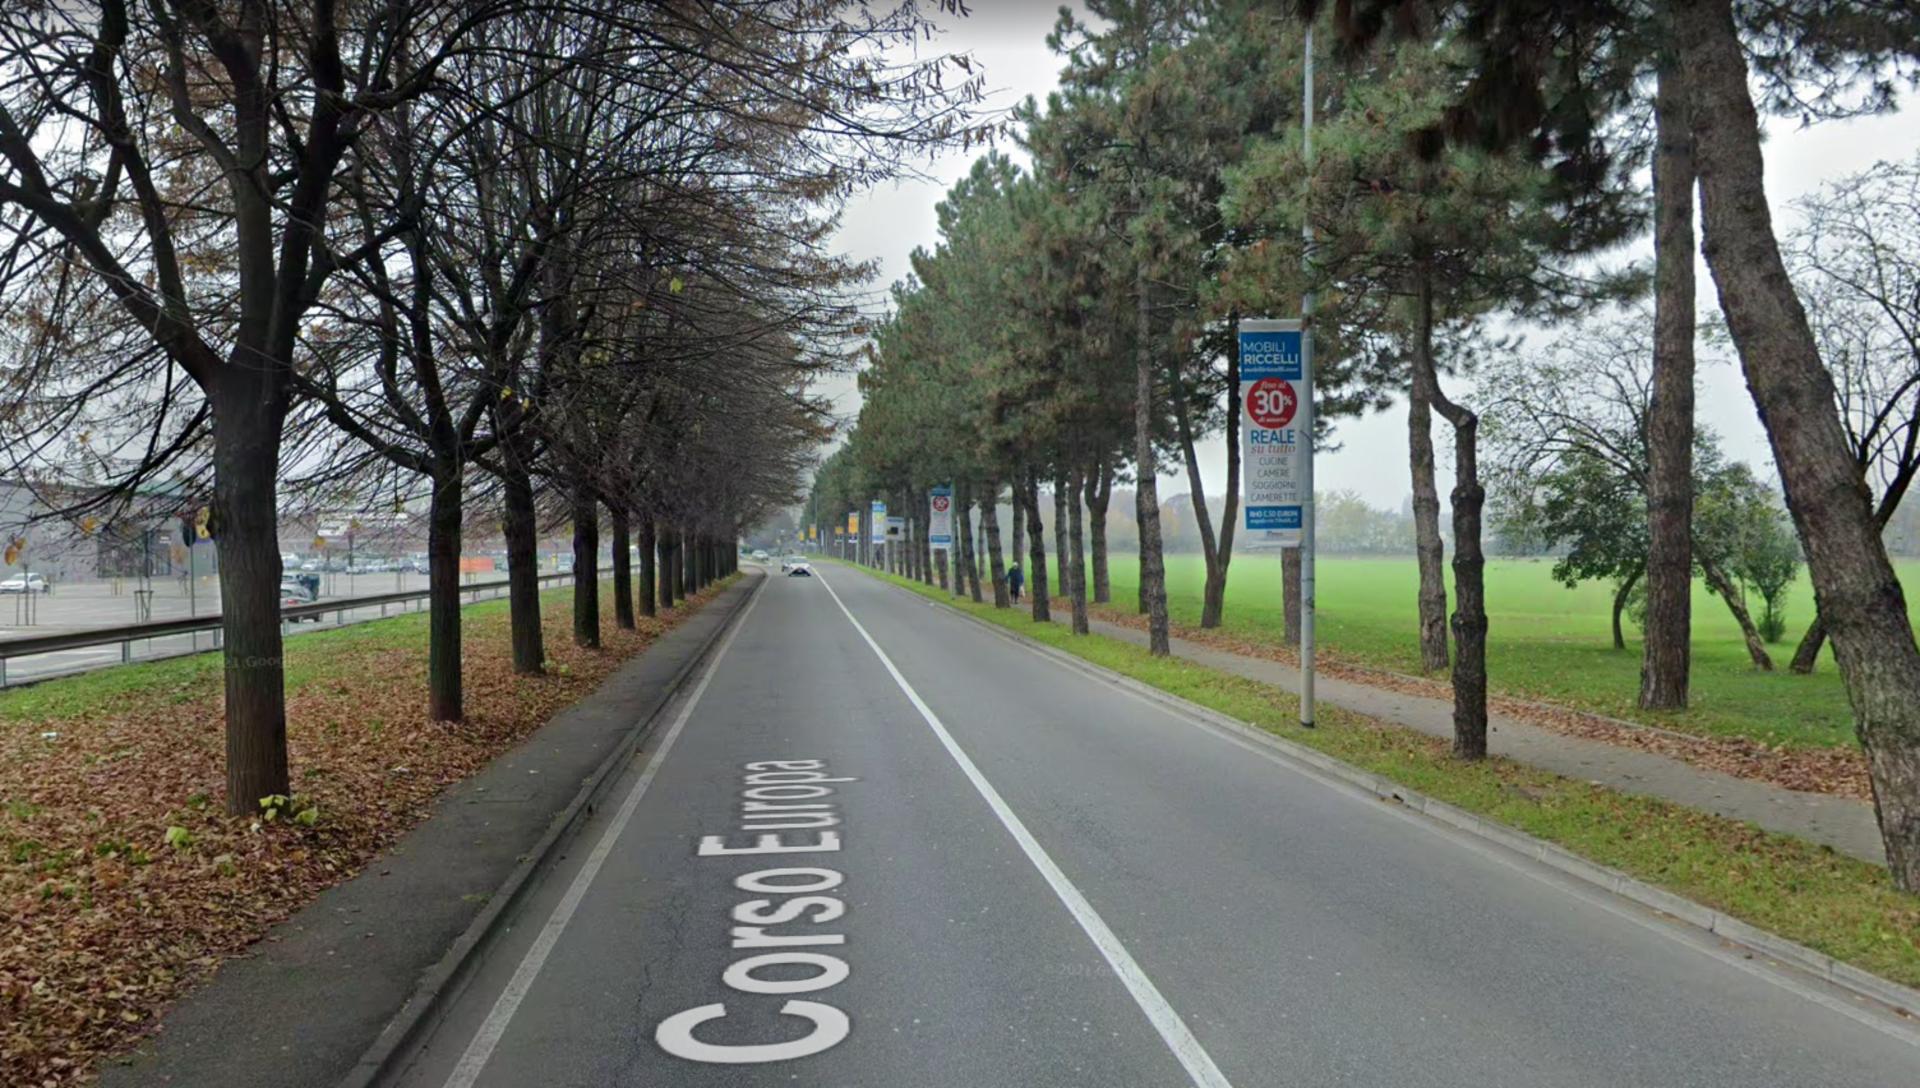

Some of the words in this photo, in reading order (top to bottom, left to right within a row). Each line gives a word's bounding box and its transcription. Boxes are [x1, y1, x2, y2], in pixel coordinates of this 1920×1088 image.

[1243, 342, 1285, 352] MOBILI
[1244, 353, 1298, 364] RICCELLI
[1250, 430, 1295, 444] REALE
